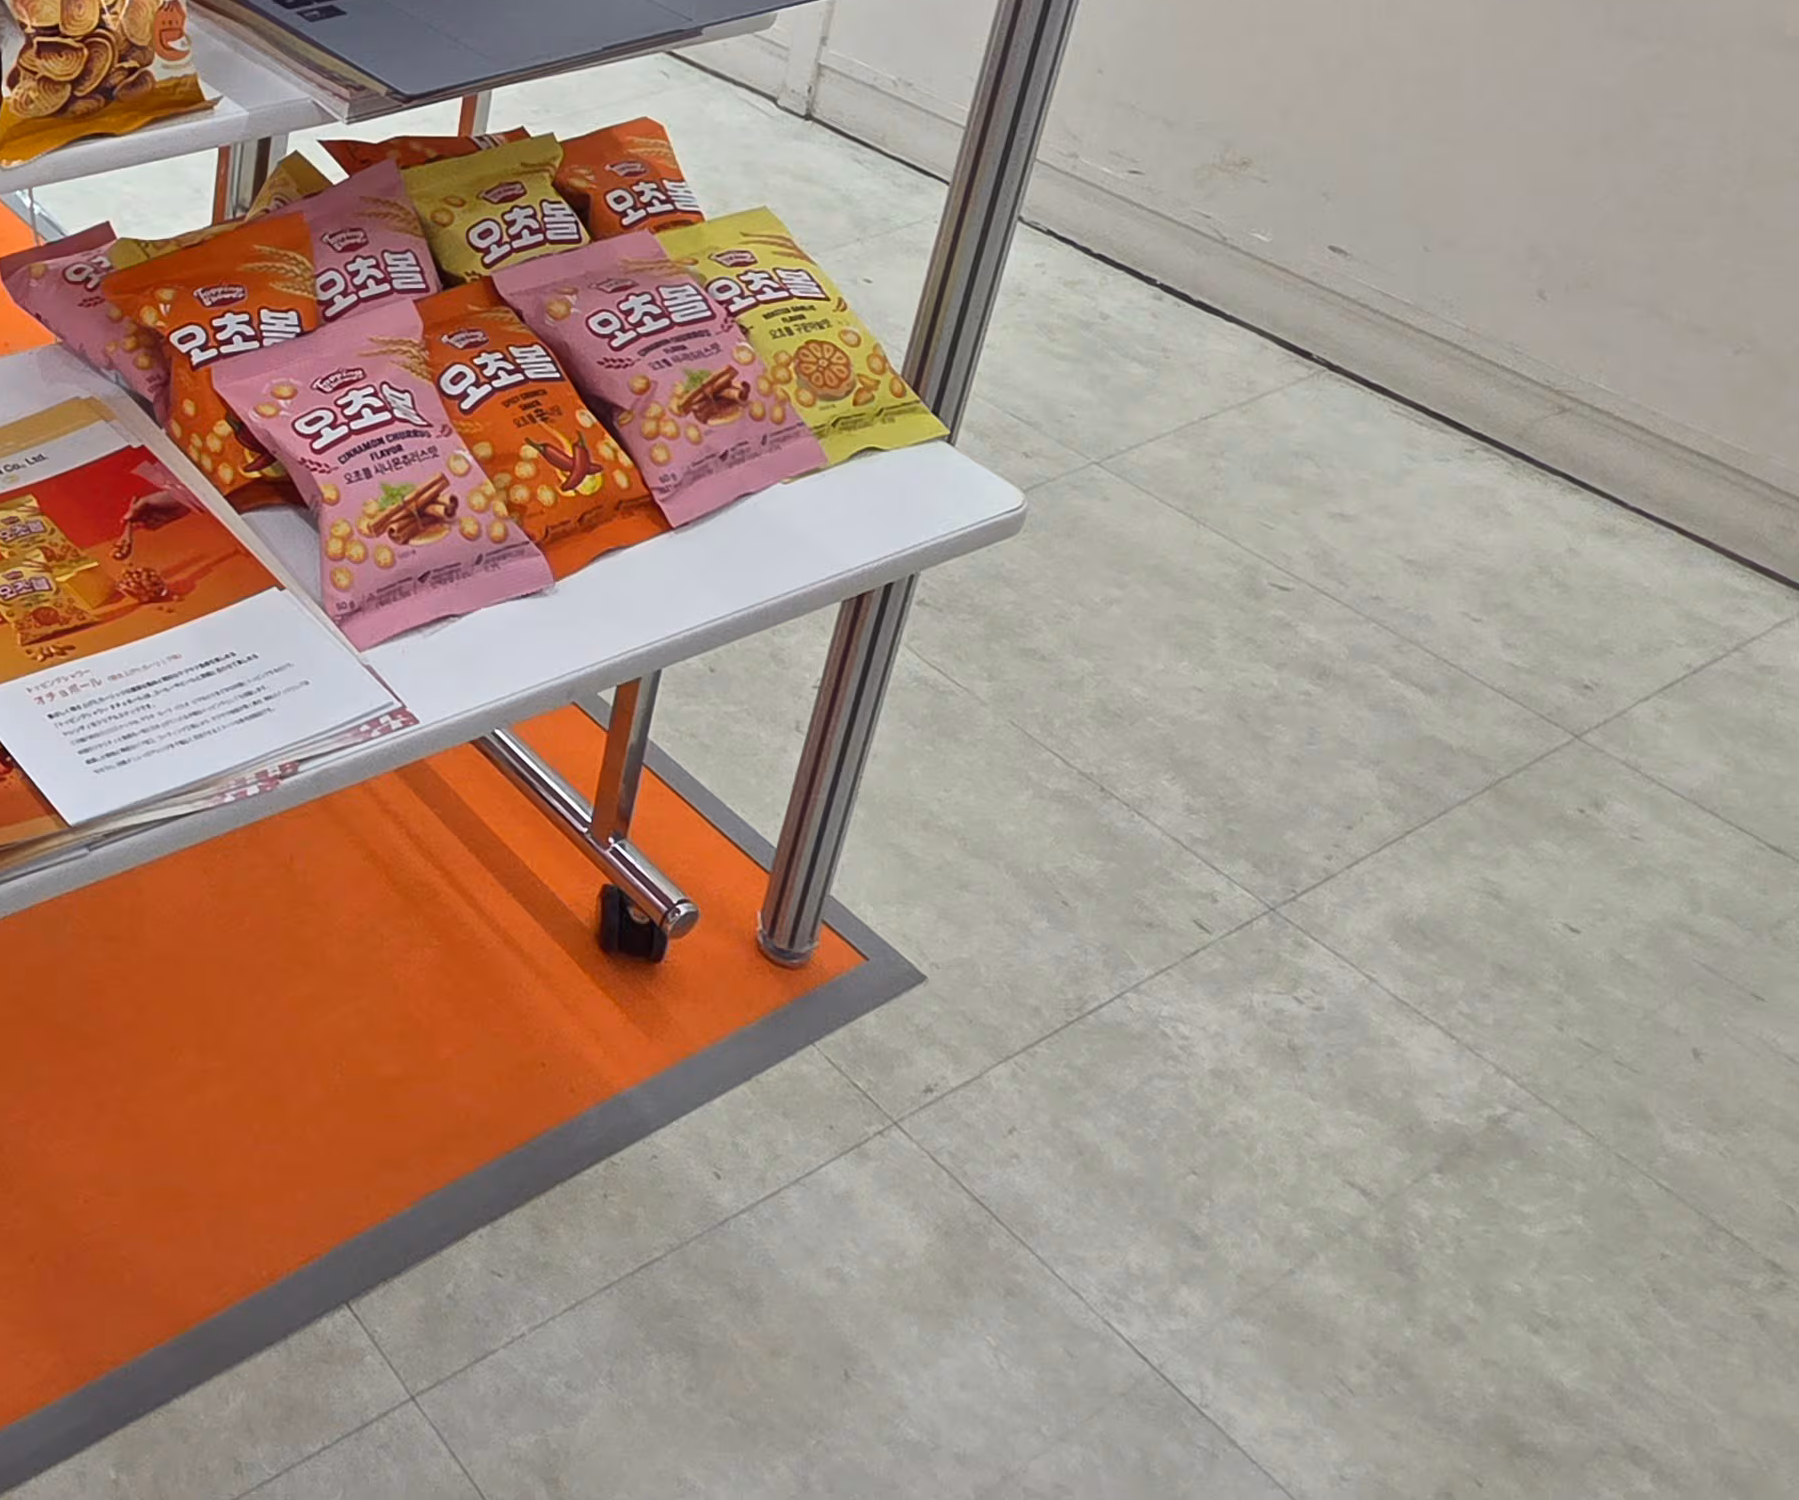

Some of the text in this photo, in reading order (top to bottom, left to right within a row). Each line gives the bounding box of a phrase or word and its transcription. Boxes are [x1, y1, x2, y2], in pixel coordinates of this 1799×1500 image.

[468, 200, 580, 265] 오초볼
[605, 179, 701, 226] 오초볼
[315, 250, 427, 318] 오초볼
[587, 284, 713, 349] 오초볼
[709, 269, 827, 313] 오초볼
[169, 308, 301, 366] 오초볼
[439, 343, 561, 410] 오초볼
[293, 382, 430, 450] 오초볼
